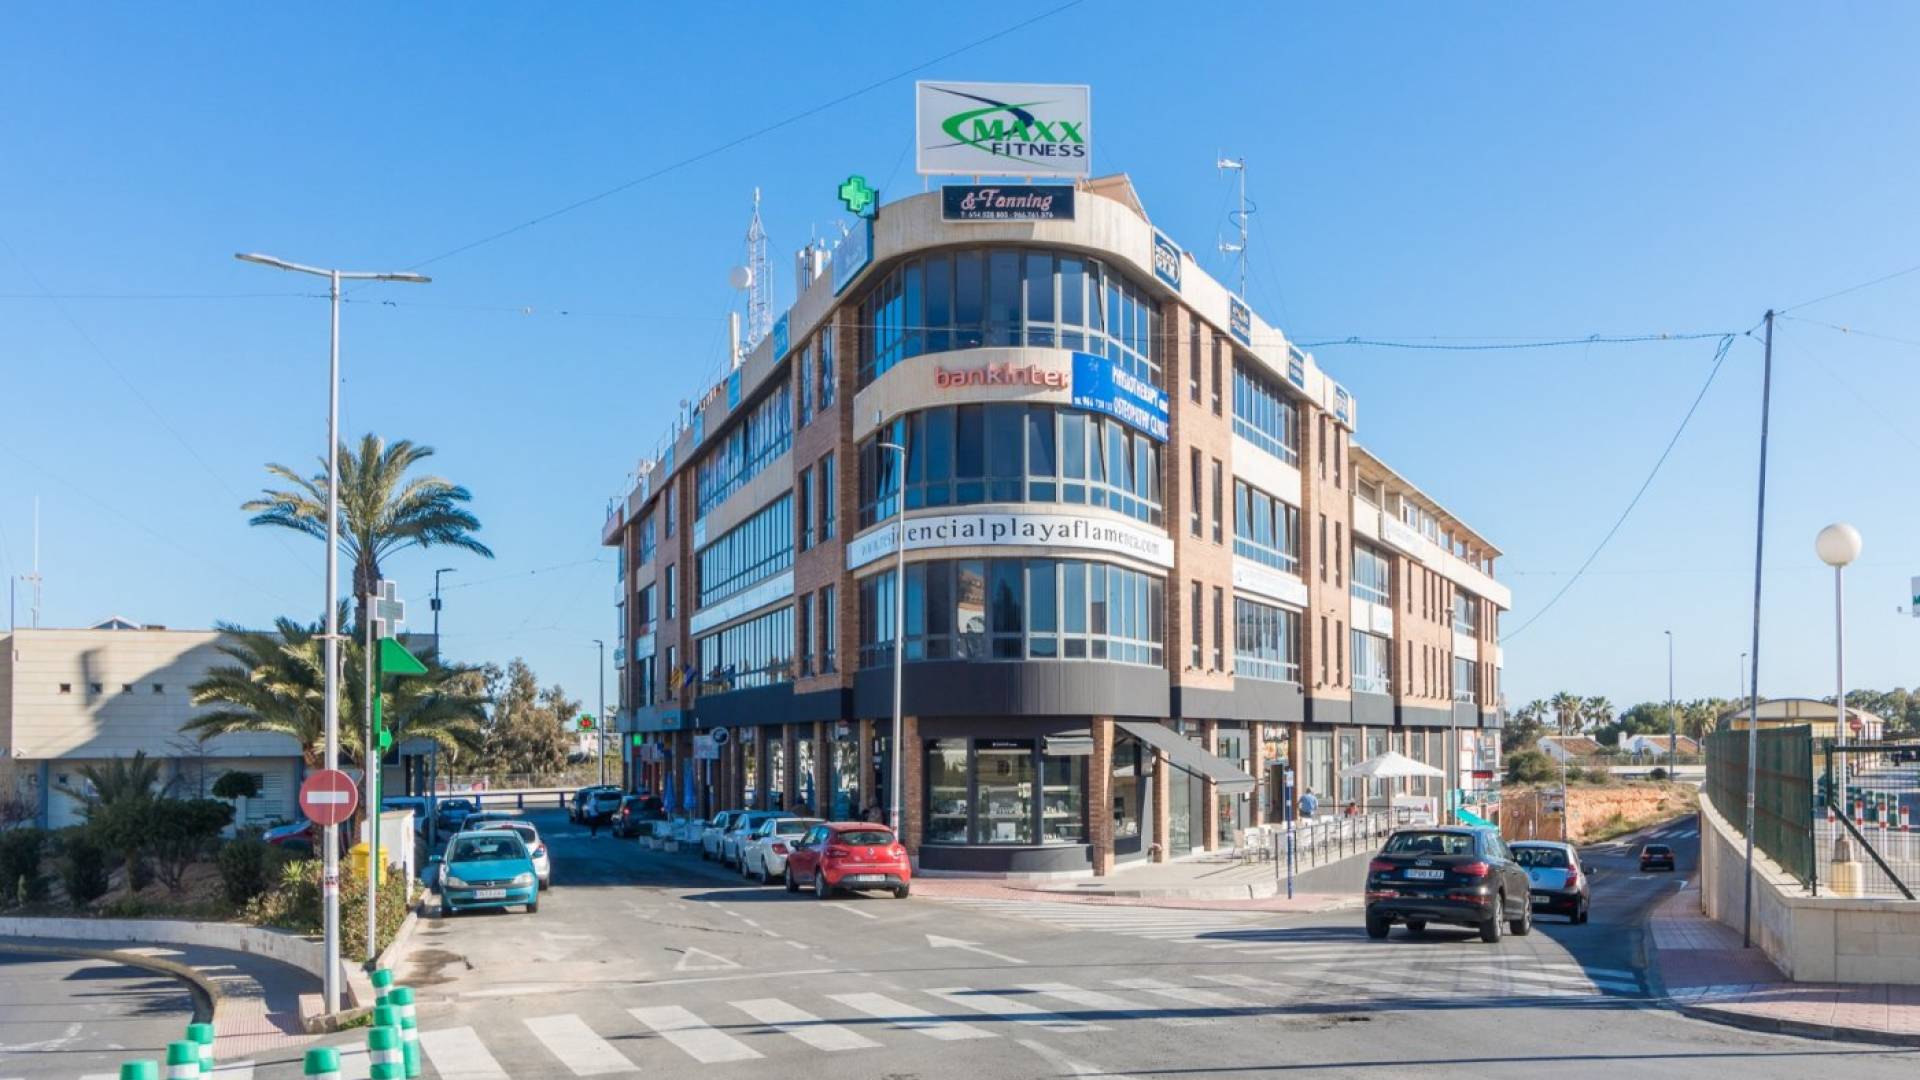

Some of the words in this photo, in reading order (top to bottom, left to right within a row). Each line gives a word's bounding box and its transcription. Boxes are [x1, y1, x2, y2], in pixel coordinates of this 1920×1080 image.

[974, 118, 1084, 143] MAXX
[992, 143, 1085, 157] FITNESS
[976, 188, 1053, 211] Tanning
[935, 360, 1069, 390] bankinter
